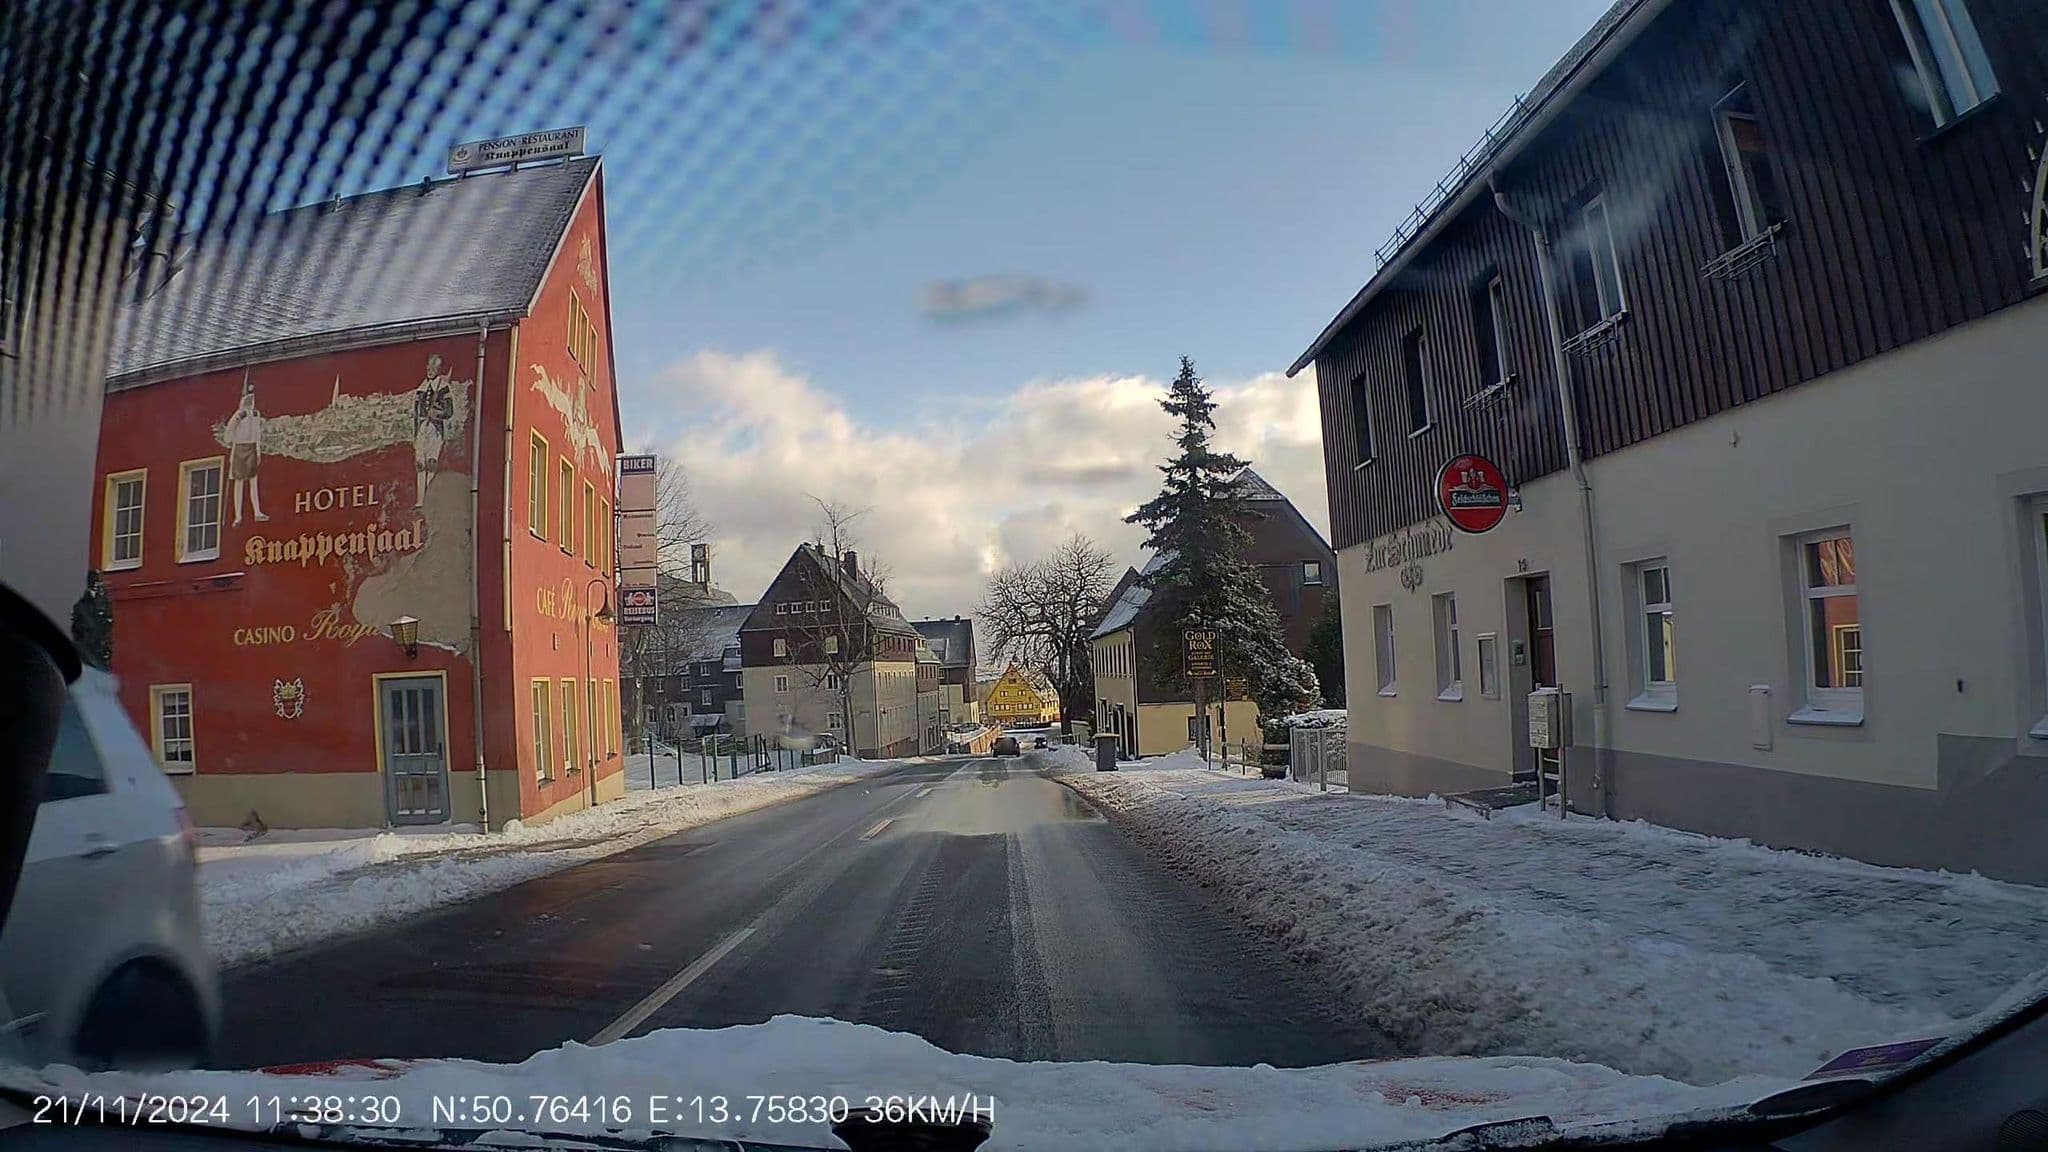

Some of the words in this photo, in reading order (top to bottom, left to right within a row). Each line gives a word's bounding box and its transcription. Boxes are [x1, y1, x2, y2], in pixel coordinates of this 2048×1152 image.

[479, 139, 516, 152] PENSION
[522, 130, 579, 145] RESTAURANT
[623, 459, 653, 470] BIKER
[295, 484, 379, 513] HOTEL
[234, 625, 295, 646] CASINO
[1185, 630, 1216, 641] GOLD
[1190, 640, 1213, 650] ROX
